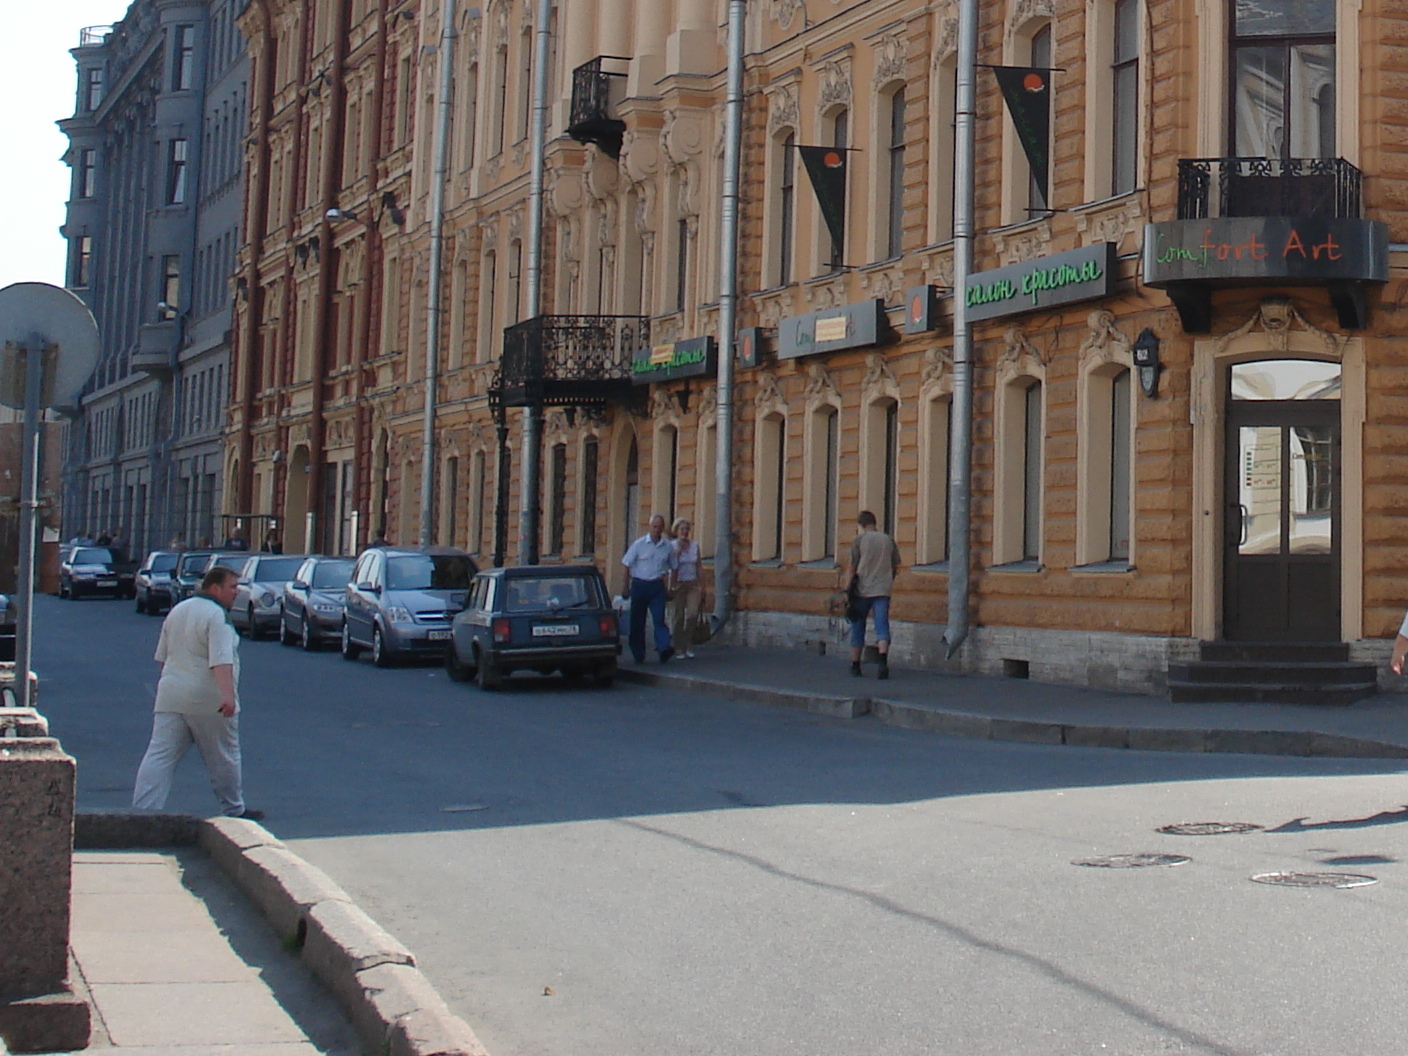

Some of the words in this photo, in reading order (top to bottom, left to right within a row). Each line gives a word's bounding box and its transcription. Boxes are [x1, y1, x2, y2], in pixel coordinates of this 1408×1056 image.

[1282, 229, 1342, 261] Art
[965, 278, 1016, 307] салон
[1021, 259, 1103, 305] красоты
